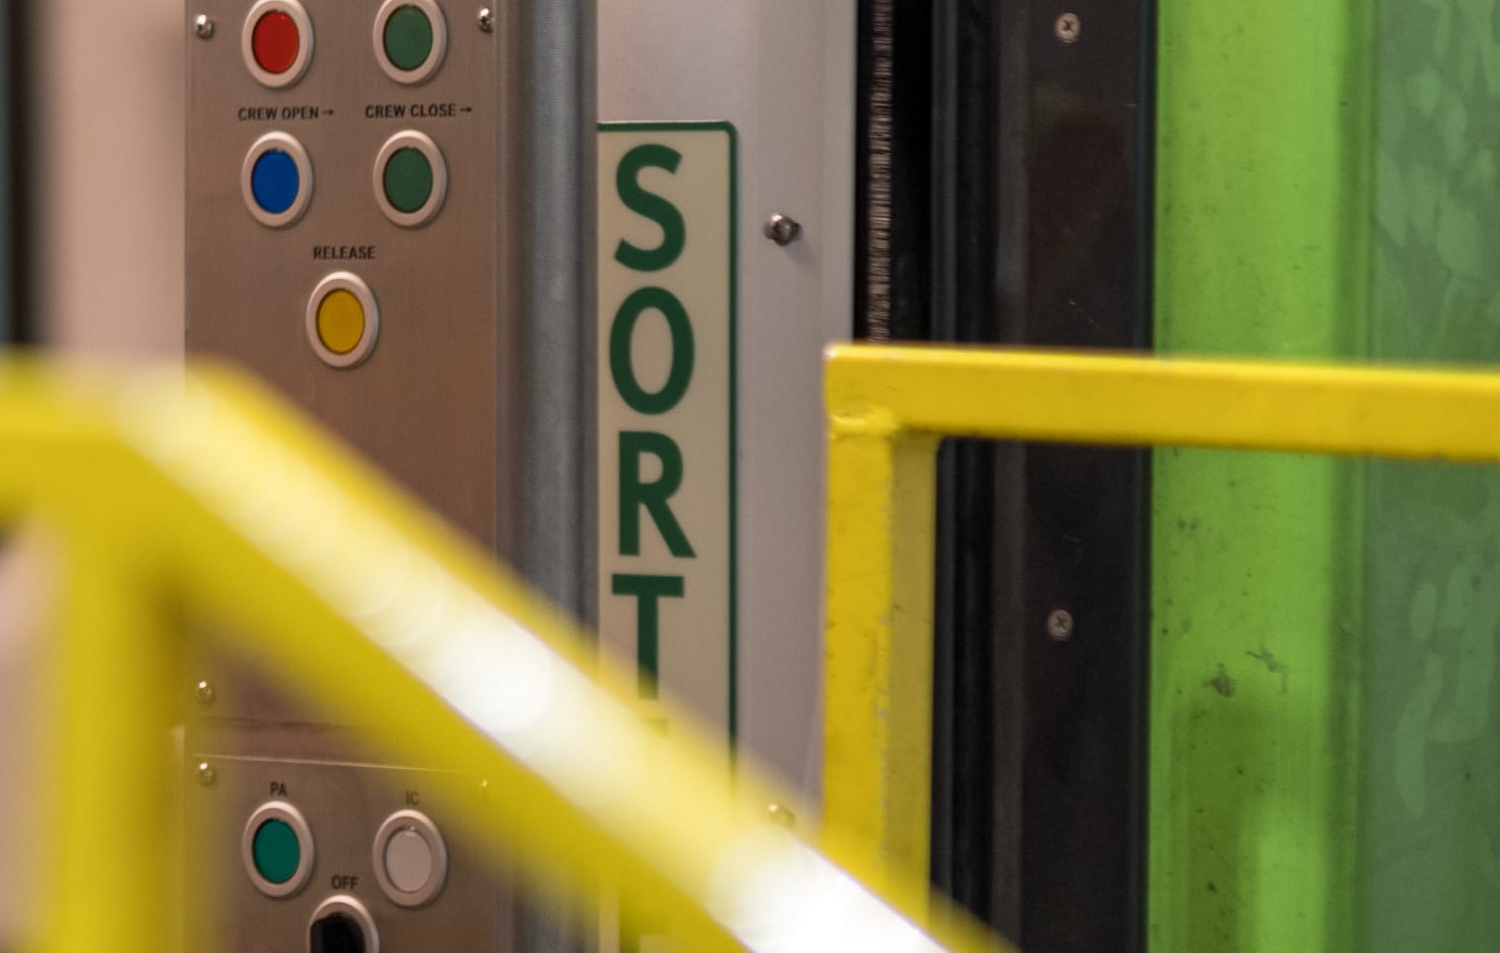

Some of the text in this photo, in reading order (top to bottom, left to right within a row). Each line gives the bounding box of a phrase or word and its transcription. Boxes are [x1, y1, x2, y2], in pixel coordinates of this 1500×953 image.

[238, 106, 319, 121] CREW OPEN
[365, 103, 457, 119] CREW CLOSE
[313, 245, 376, 261] RELEASE
[269, 782, 288, 797] PA
[405, 791, 420, 806] IC
[331, 875, 359, 890] OFF
